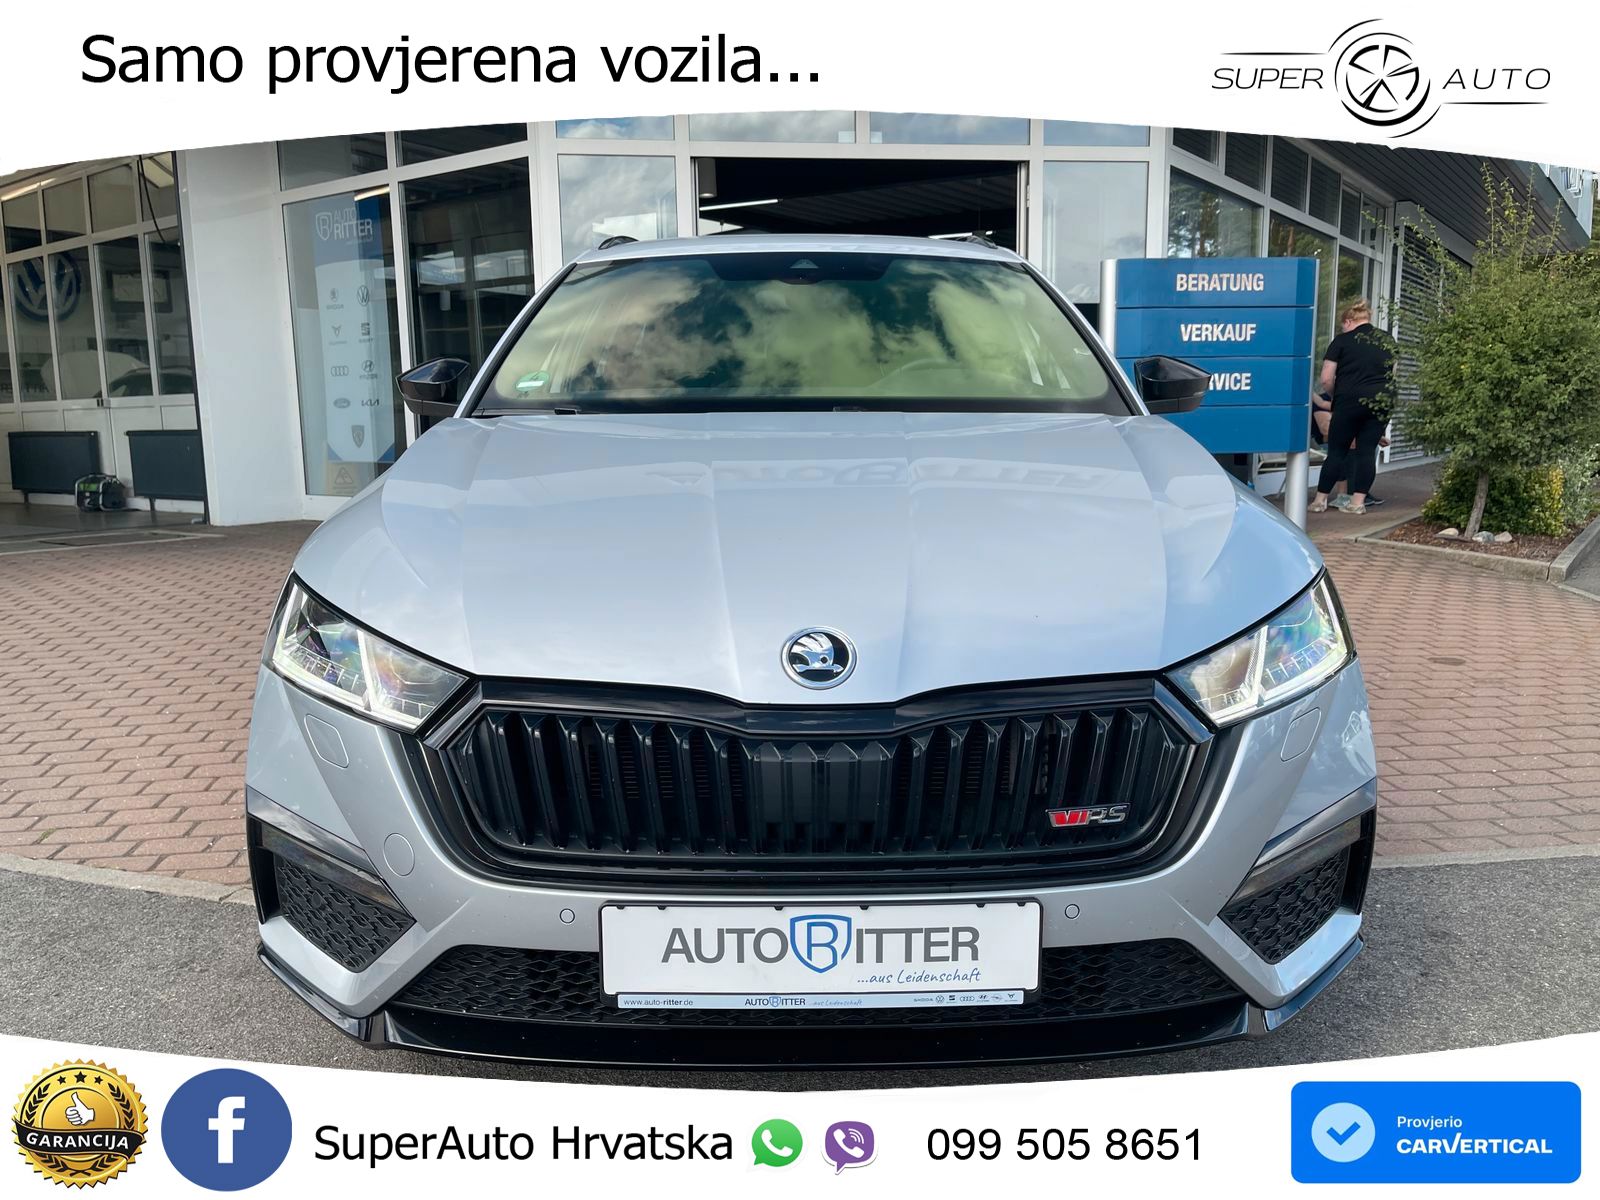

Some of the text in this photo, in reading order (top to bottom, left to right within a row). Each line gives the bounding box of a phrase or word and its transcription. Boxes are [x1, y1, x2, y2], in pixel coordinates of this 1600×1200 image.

[334, 207, 357, 222] AUTO
[333, 218, 374, 240] RITTER
[1176, 273, 1264, 292] BERATUNG
[1180, 323, 1257, 342] VERKAUF
[1208, 372, 1252, 391] VICE
[896, 967, 982, 985] Leidenschaft
[623, 998, 694, 1007] www.auto-ritter.de
